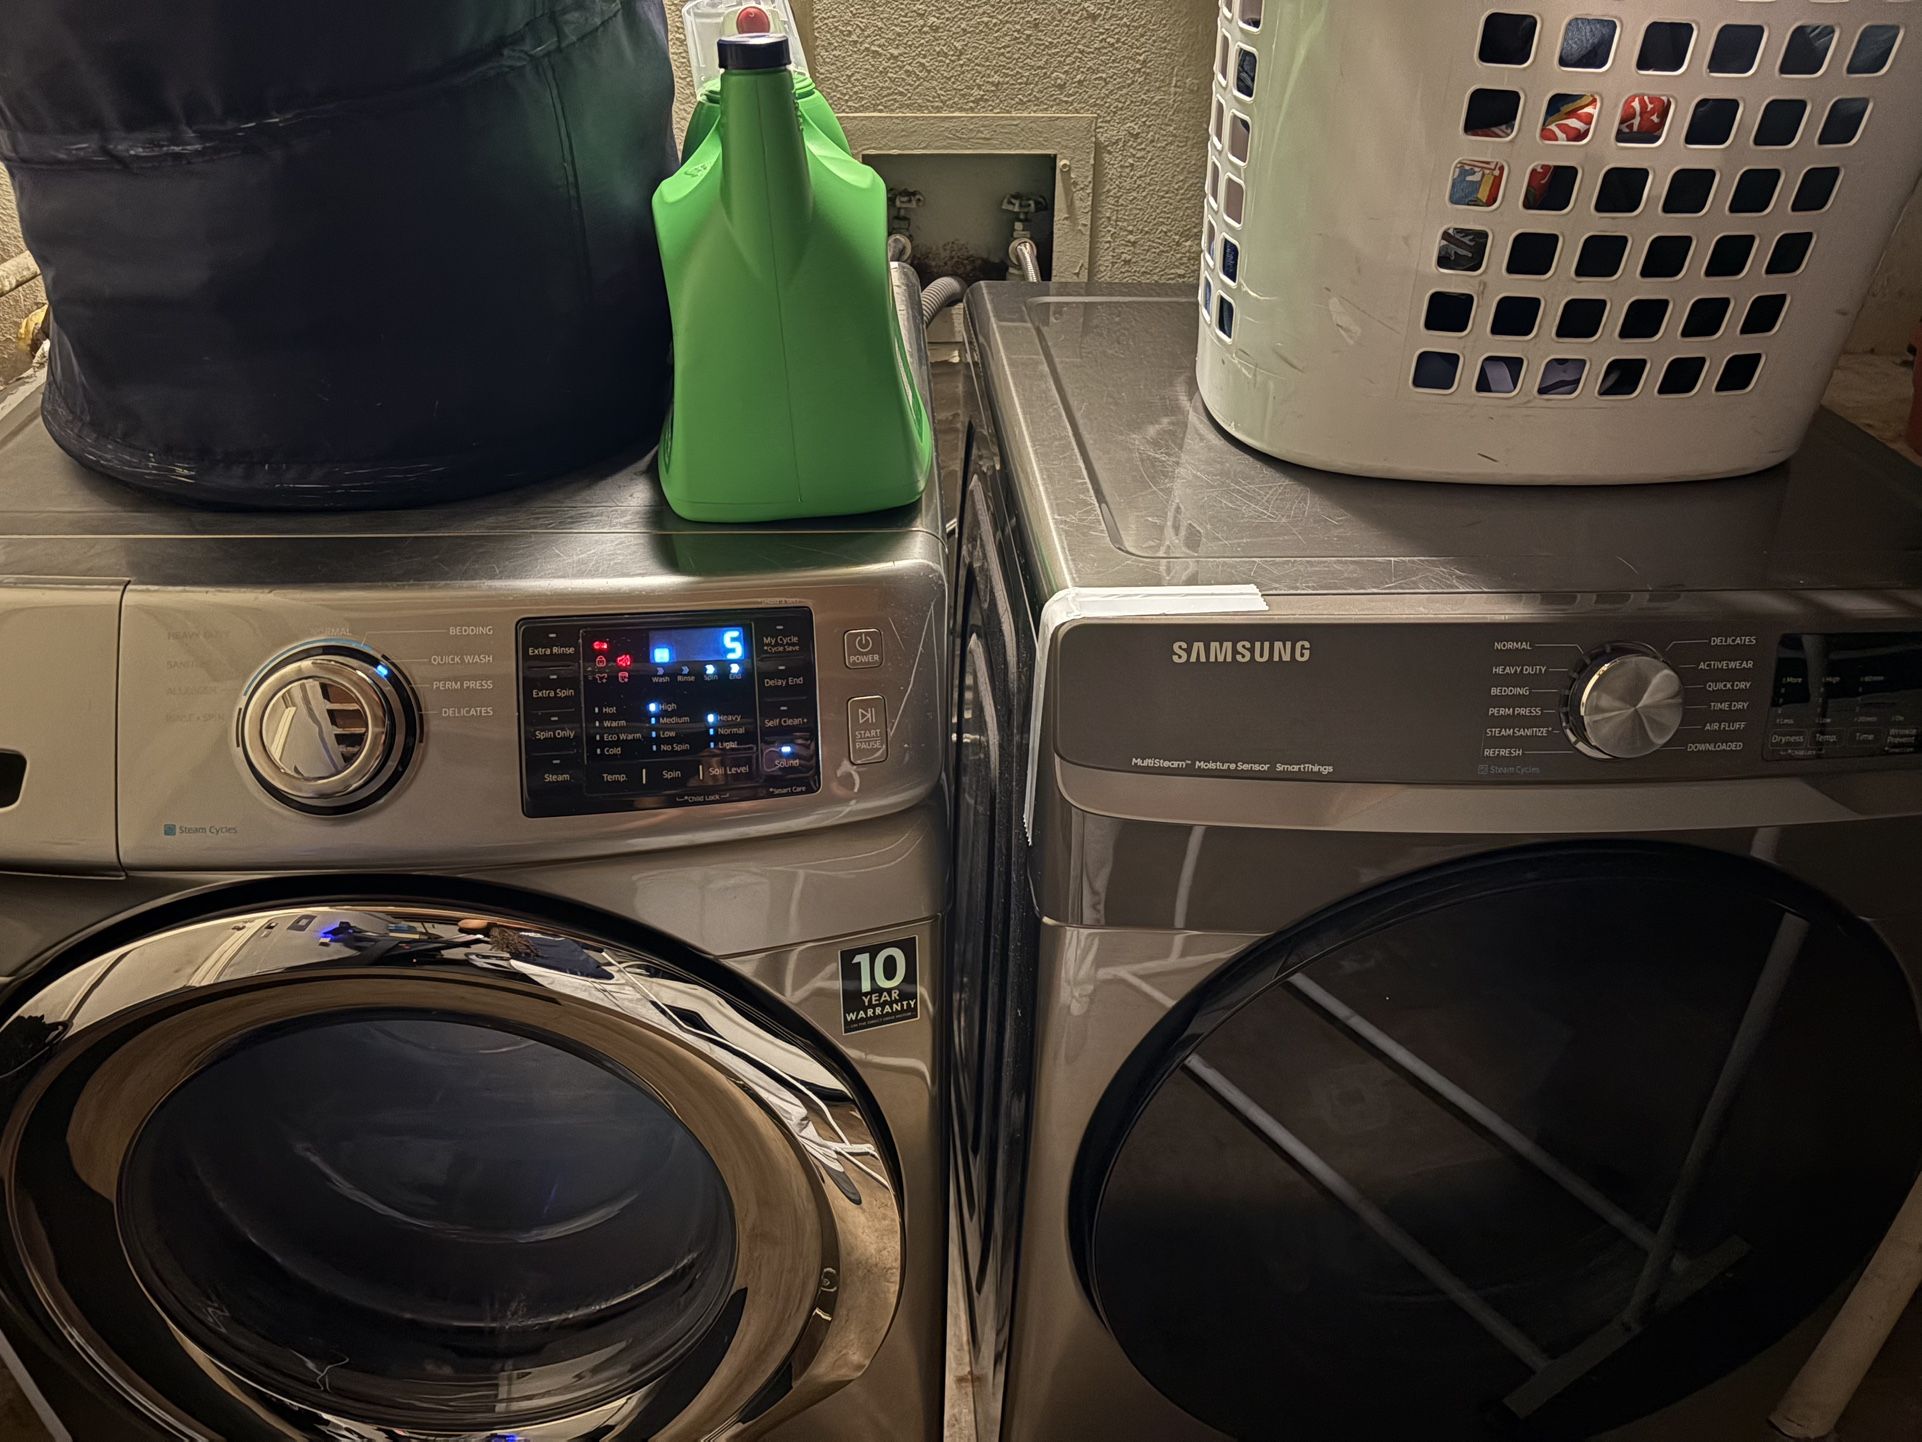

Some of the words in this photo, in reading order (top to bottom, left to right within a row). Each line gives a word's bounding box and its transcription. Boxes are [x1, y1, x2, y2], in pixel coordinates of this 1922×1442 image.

[449, 627, 493, 635] BEDDING
[778, 635, 798, 644] Cycle
[1710, 637, 1756, 645] DELICATES
[724, 631, 743, 659] 5
[1494, 642, 1532, 650] NORMAL
[529, 647, 550, 655] Extra
[552, 646, 575, 654] Rinse
[1172, 640, 1311, 663] SAMSUNG
[431, 655, 460, 664] QUICK
[464, 655, 493, 663] WASH
[850, 655, 879, 663] POWER
[1698, 661, 1753, 669] ACTIVEWEAR
[1493, 666, 1522, 674] HEAVY
[1523, 666, 1546, 674] DUTY
[433, 681, 460, 690] PERM
[463, 680, 493, 689] PRESS
[765, 678, 786, 686] Delay
[789, 677, 803, 685] End
[1706, 682, 1730, 690] QUICK
[1732, 681, 1751, 690] DRY
[556, 689, 574, 697] Spin
[1491, 687, 1529, 695] BEDDING
[1710, 702, 1730, 710] TIME
[1732, 702, 1749, 710] DRY
[442, 707, 493, 717] DELICATES
[1489, 708, 1512, 716] PERM
[1514, 707, 1541, 716] PRESS
[765, 718, 779, 726] Self
[1705, 723, 1718, 731] AIR
[1721, 722, 1747, 730] FLUFF
[535, 731, 554, 739] Spin
[556, 729, 575, 738] Only
[619, 732, 641, 740] Warm
[855, 729, 881, 739] START
[1486, 728, 1513, 736] STEAM
[1772, 734, 1804, 743] Dryness
[856, 740, 881, 749] PAUSE
[1687, 742, 1743, 751] DOWNLOADED
[1484, 748, 1522, 757] REFRESH
[775, 759, 799, 767] Sound
[1196, 761, 1235, 770] Moisture
[1237, 762, 1270, 771] Sensor
[1276, 763, 1333, 774] SmartThings
[709, 767, 725, 775] Soil
[727, 766, 749, 774] Level
[179, 825, 206, 834] Steam
[209, 825, 237, 835] Cycles
[852, 947, 906, 993] 10
[862, 990, 899, 1004] YEAR
[846, 998, 916, 1021] WARRANTY
